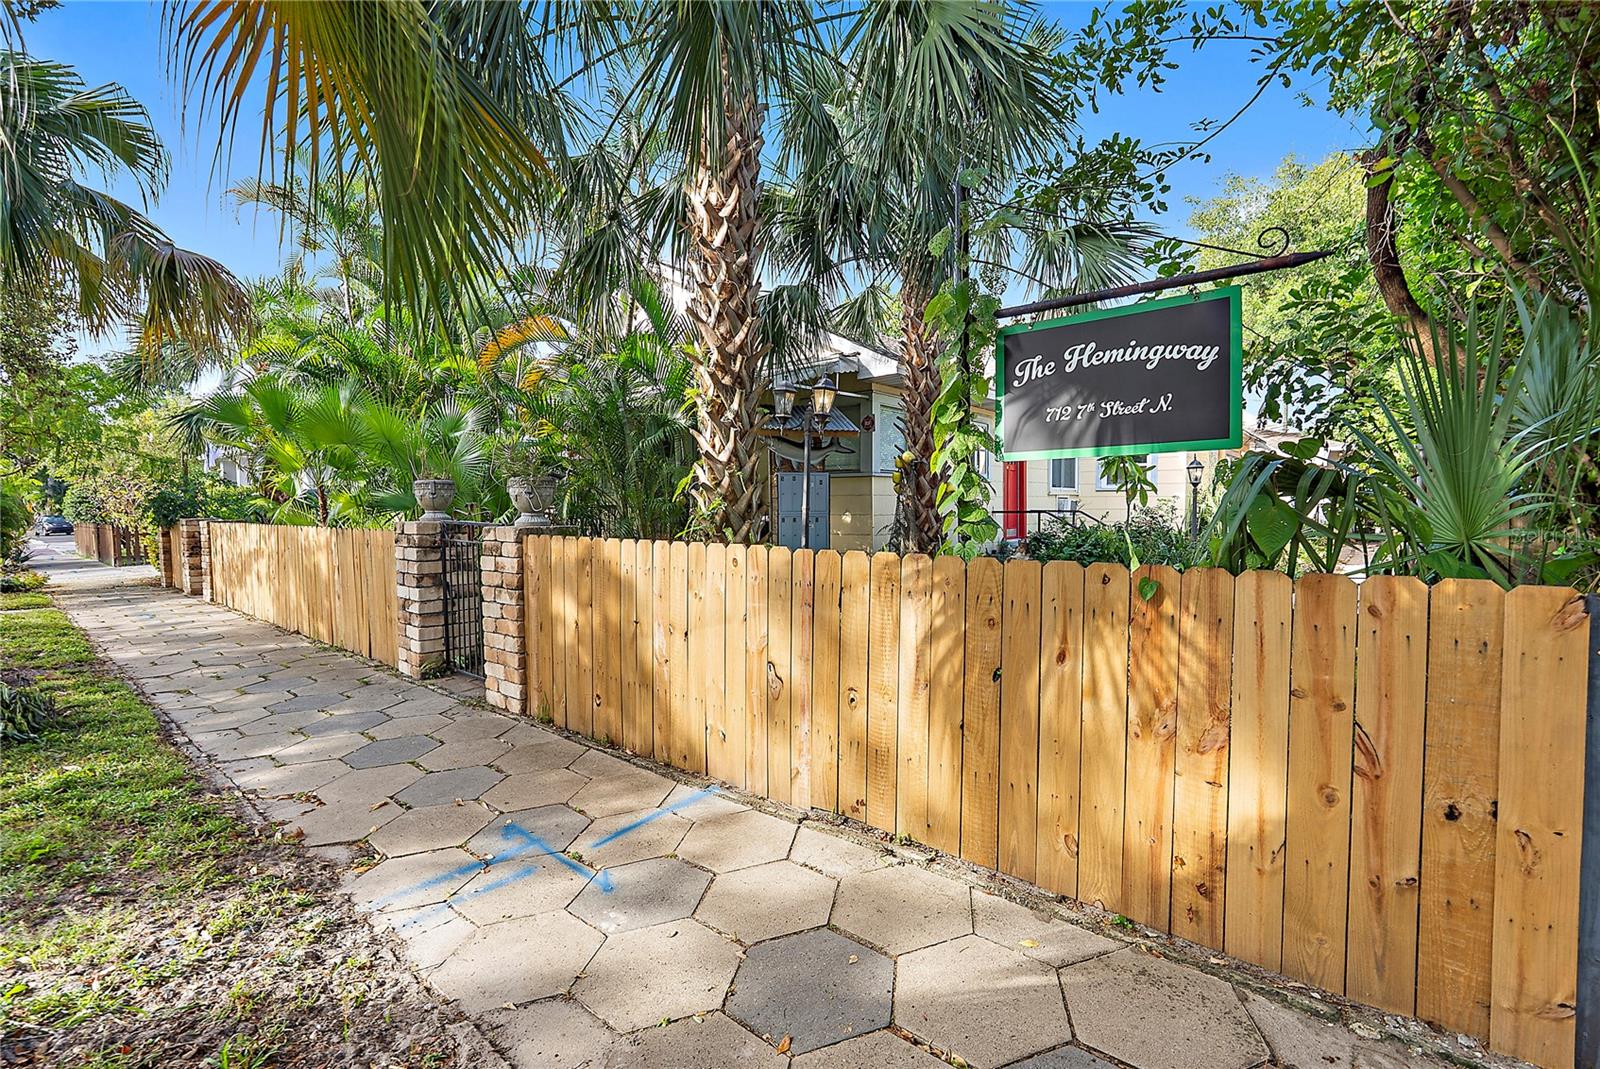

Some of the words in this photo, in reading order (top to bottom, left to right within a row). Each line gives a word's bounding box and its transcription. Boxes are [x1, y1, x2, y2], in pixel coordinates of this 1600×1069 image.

[1012, 354, 1056, 388] The
[1063, 340, 1220, 371] Hemingway
[1045, 406, 1071, 423] 712
[1077, 401, 1095, 420] 7th
[1099, 397, 1150, 418] Street
[1150, 393, 1173, 415] N.
